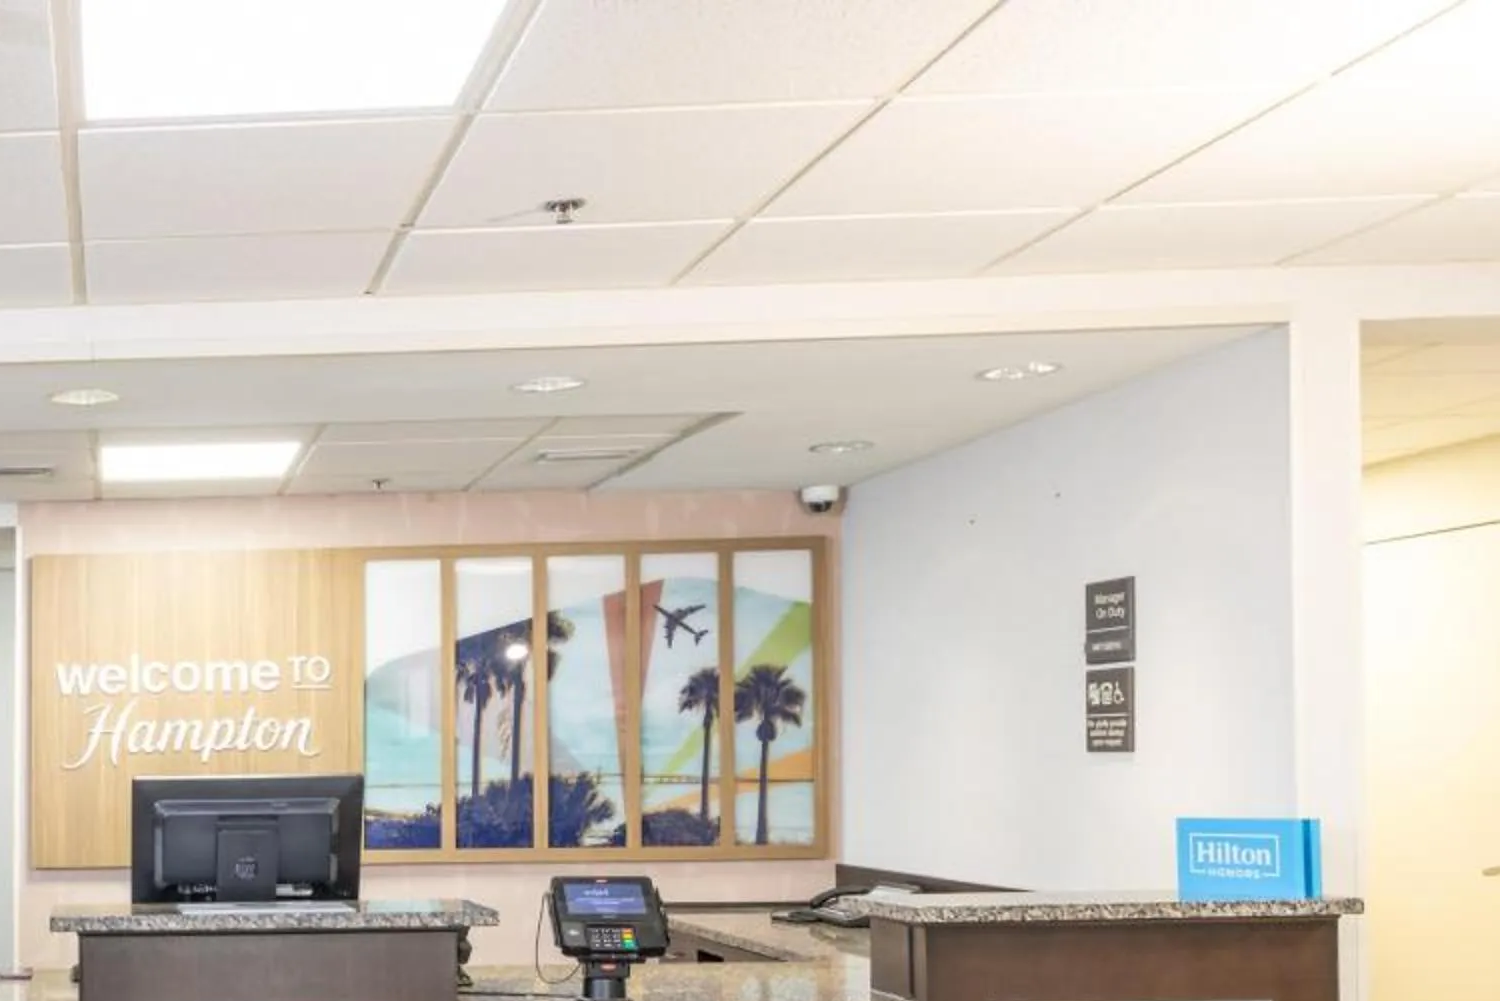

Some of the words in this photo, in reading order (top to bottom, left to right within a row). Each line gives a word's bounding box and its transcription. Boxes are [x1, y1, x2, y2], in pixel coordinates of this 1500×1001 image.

[57, 654, 281, 695] welcome
[288, 656, 331, 683] TO
[60, 700, 321, 769] Hampton
[1196, 841, 1273, 866] Hilton
